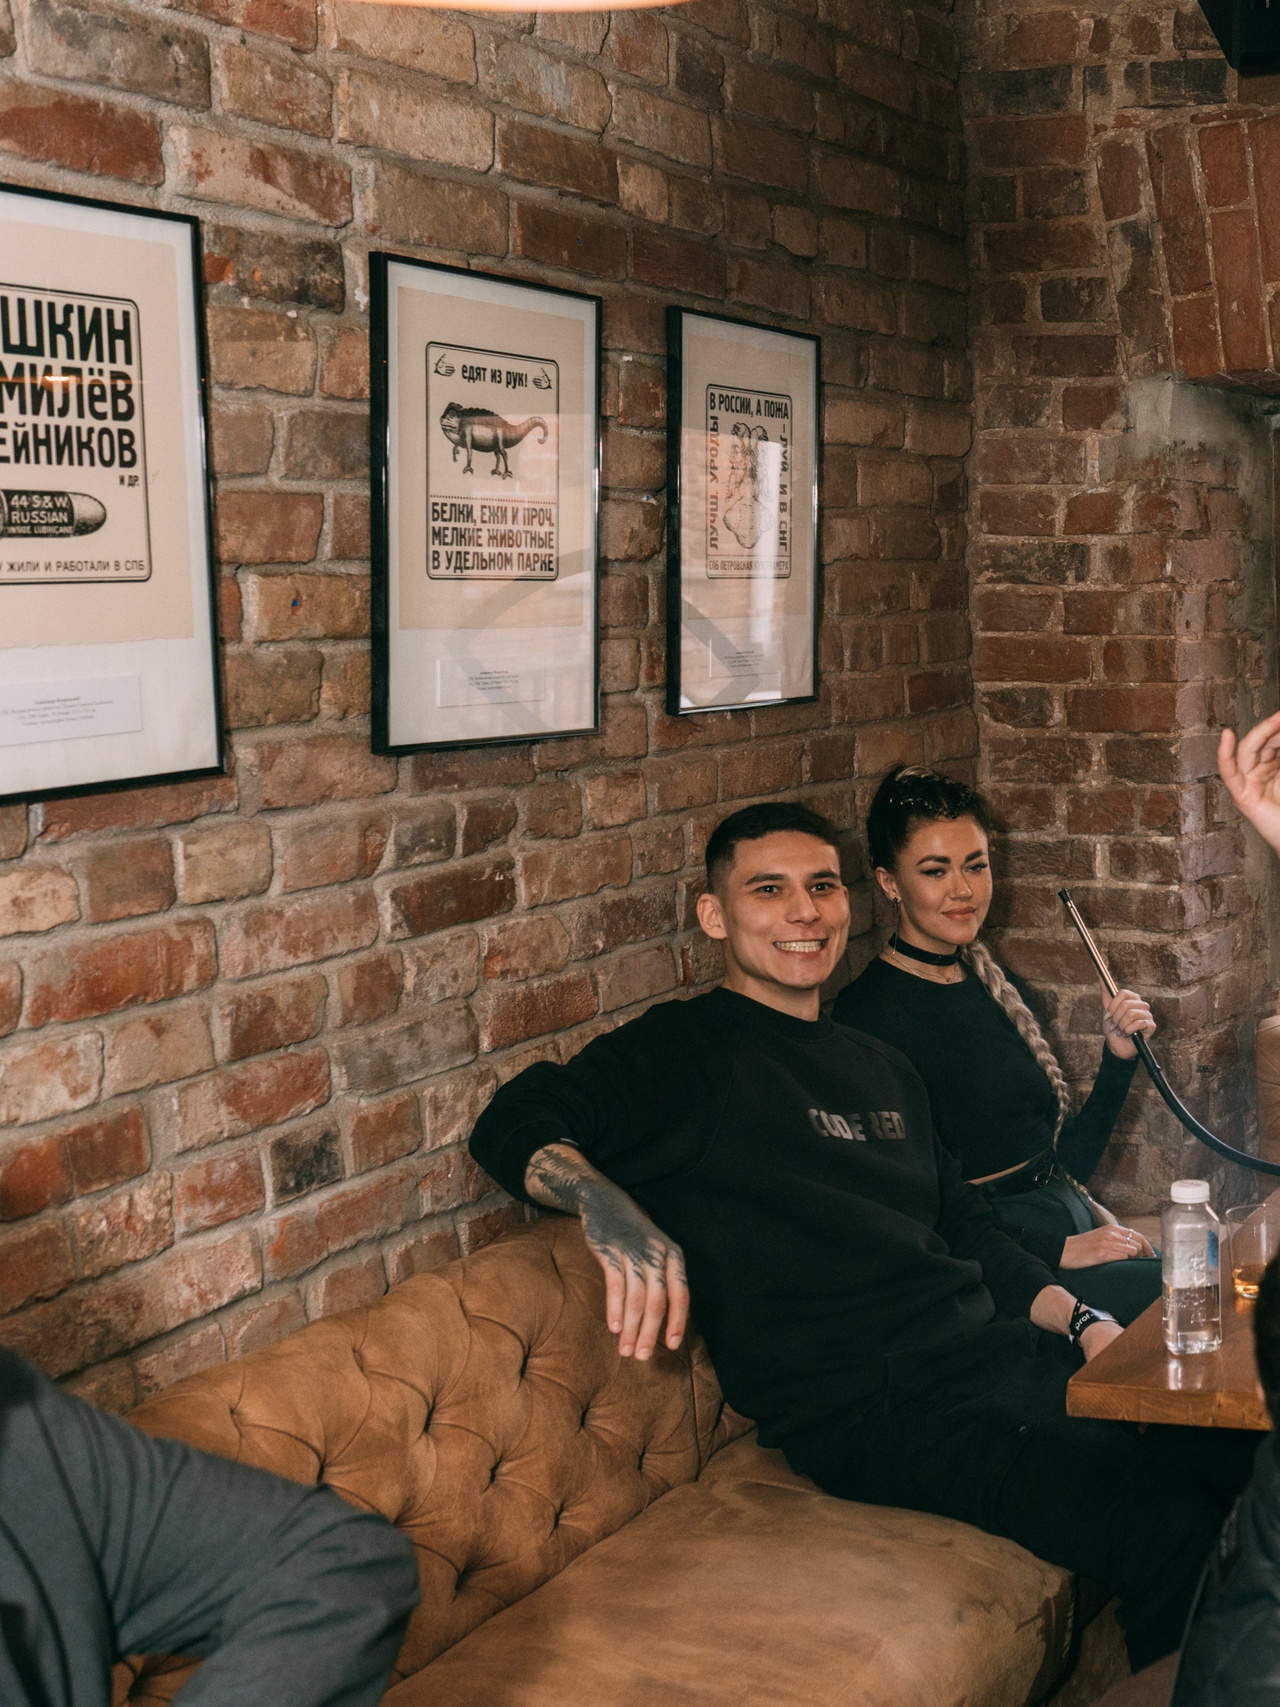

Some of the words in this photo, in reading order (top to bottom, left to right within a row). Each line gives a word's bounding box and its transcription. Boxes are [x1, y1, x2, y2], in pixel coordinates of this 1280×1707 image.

[1, 295, 132, 365] ШКИН
[461, 364, 487, 383] едят
[491, 368, 502, 384] из
[506, 371, 528, 389] рук!
[710, 392, 716, 410] В
[719, 393, 754, 418] РОССИИ,
[756, 398, 762, 416] А
[764, 399, 789, 419] ПОЖА
[709, 415, 719, 483] УРОДЫ
[780, 484, 788, 495] И
[11, 511, 68, 524] RUSSIAN
[432, 502, 477, 526] БЕЛКИ,
[480, 504, 507, 525] ЕЖИ
[512, 506, 519, 525] И
[523, 507, 554, 527] ПРОЧ.
[780, 501, 788, 513] В
[432, 526, 483, 548] МЕЛКИЕ
[487, 528, 554, 549] ЖИВОТНЫЕ
[780, 521, 788, 552] СНГ
[7, 561, 39, 572] ЖИЛИ
[44, 561, 52, 572] И
[56, 560, 110, 572] РАБОТАЛИ
[114, 560, 120, 571] В
[124, 560, 145, 571] СПБ
[432, 550, 440, 570] В
[445, 550, 513, 573] УДЕЛЬНОМ
[517, 552, 554, 572] ПАРКЕ
[720, 560, 753, 571] ПЕТРОВСКАЯ
[808, 1108, 867, 1141] CODE
[864, 1111, 906, 1140] RED
